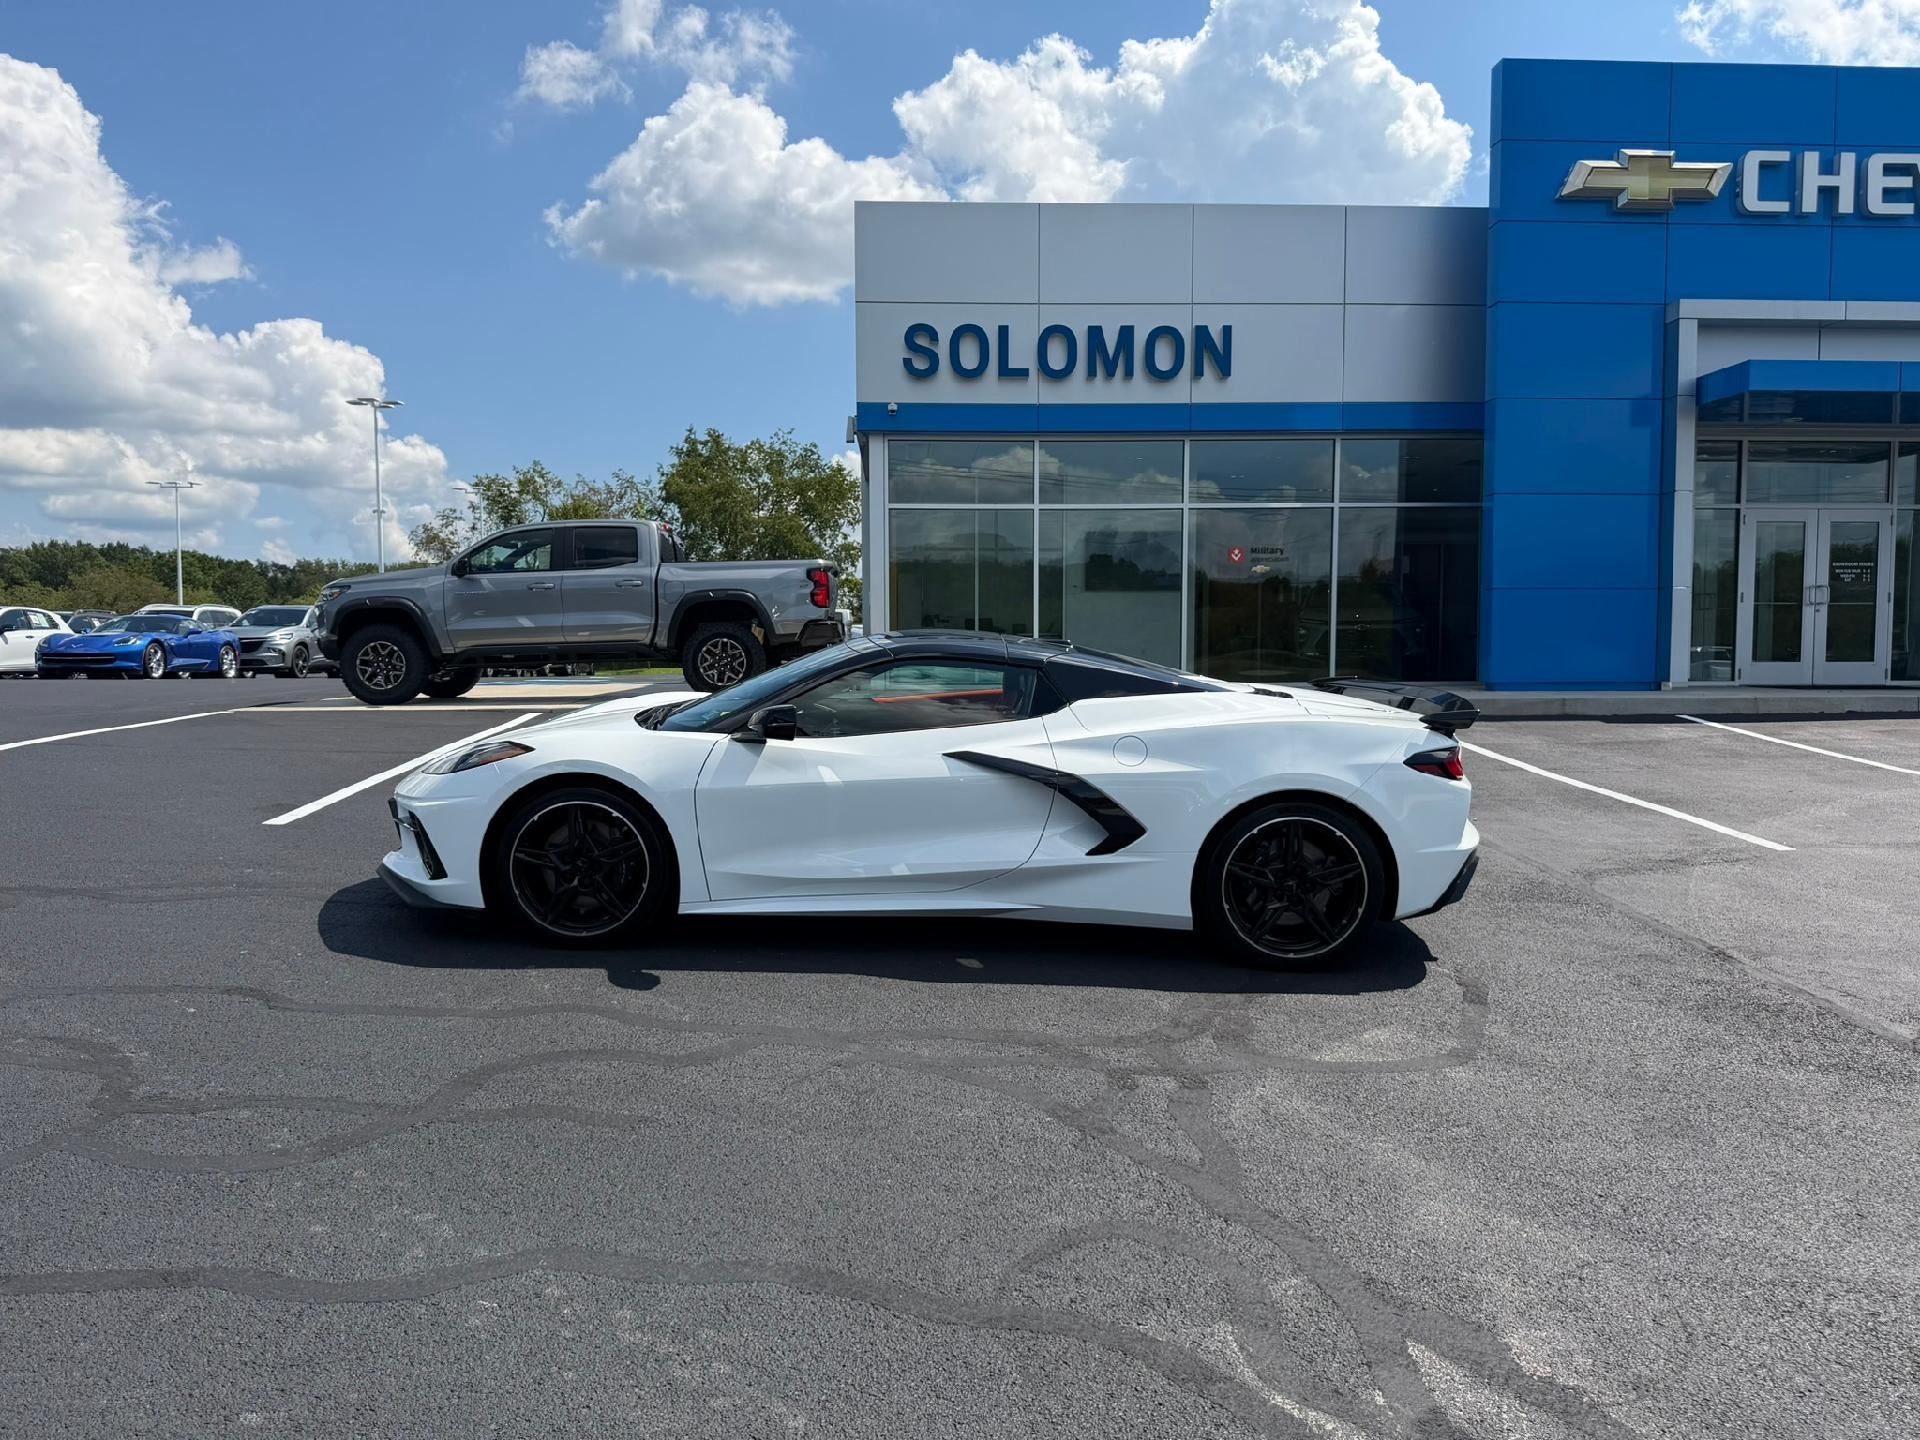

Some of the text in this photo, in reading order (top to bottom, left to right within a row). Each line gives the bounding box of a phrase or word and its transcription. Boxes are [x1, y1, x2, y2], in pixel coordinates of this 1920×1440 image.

[1740, 149, 1920, 215] CHE
[902, 322, 1233, 381] SOLOMON
[1250, 546, 1284, 556] Military
